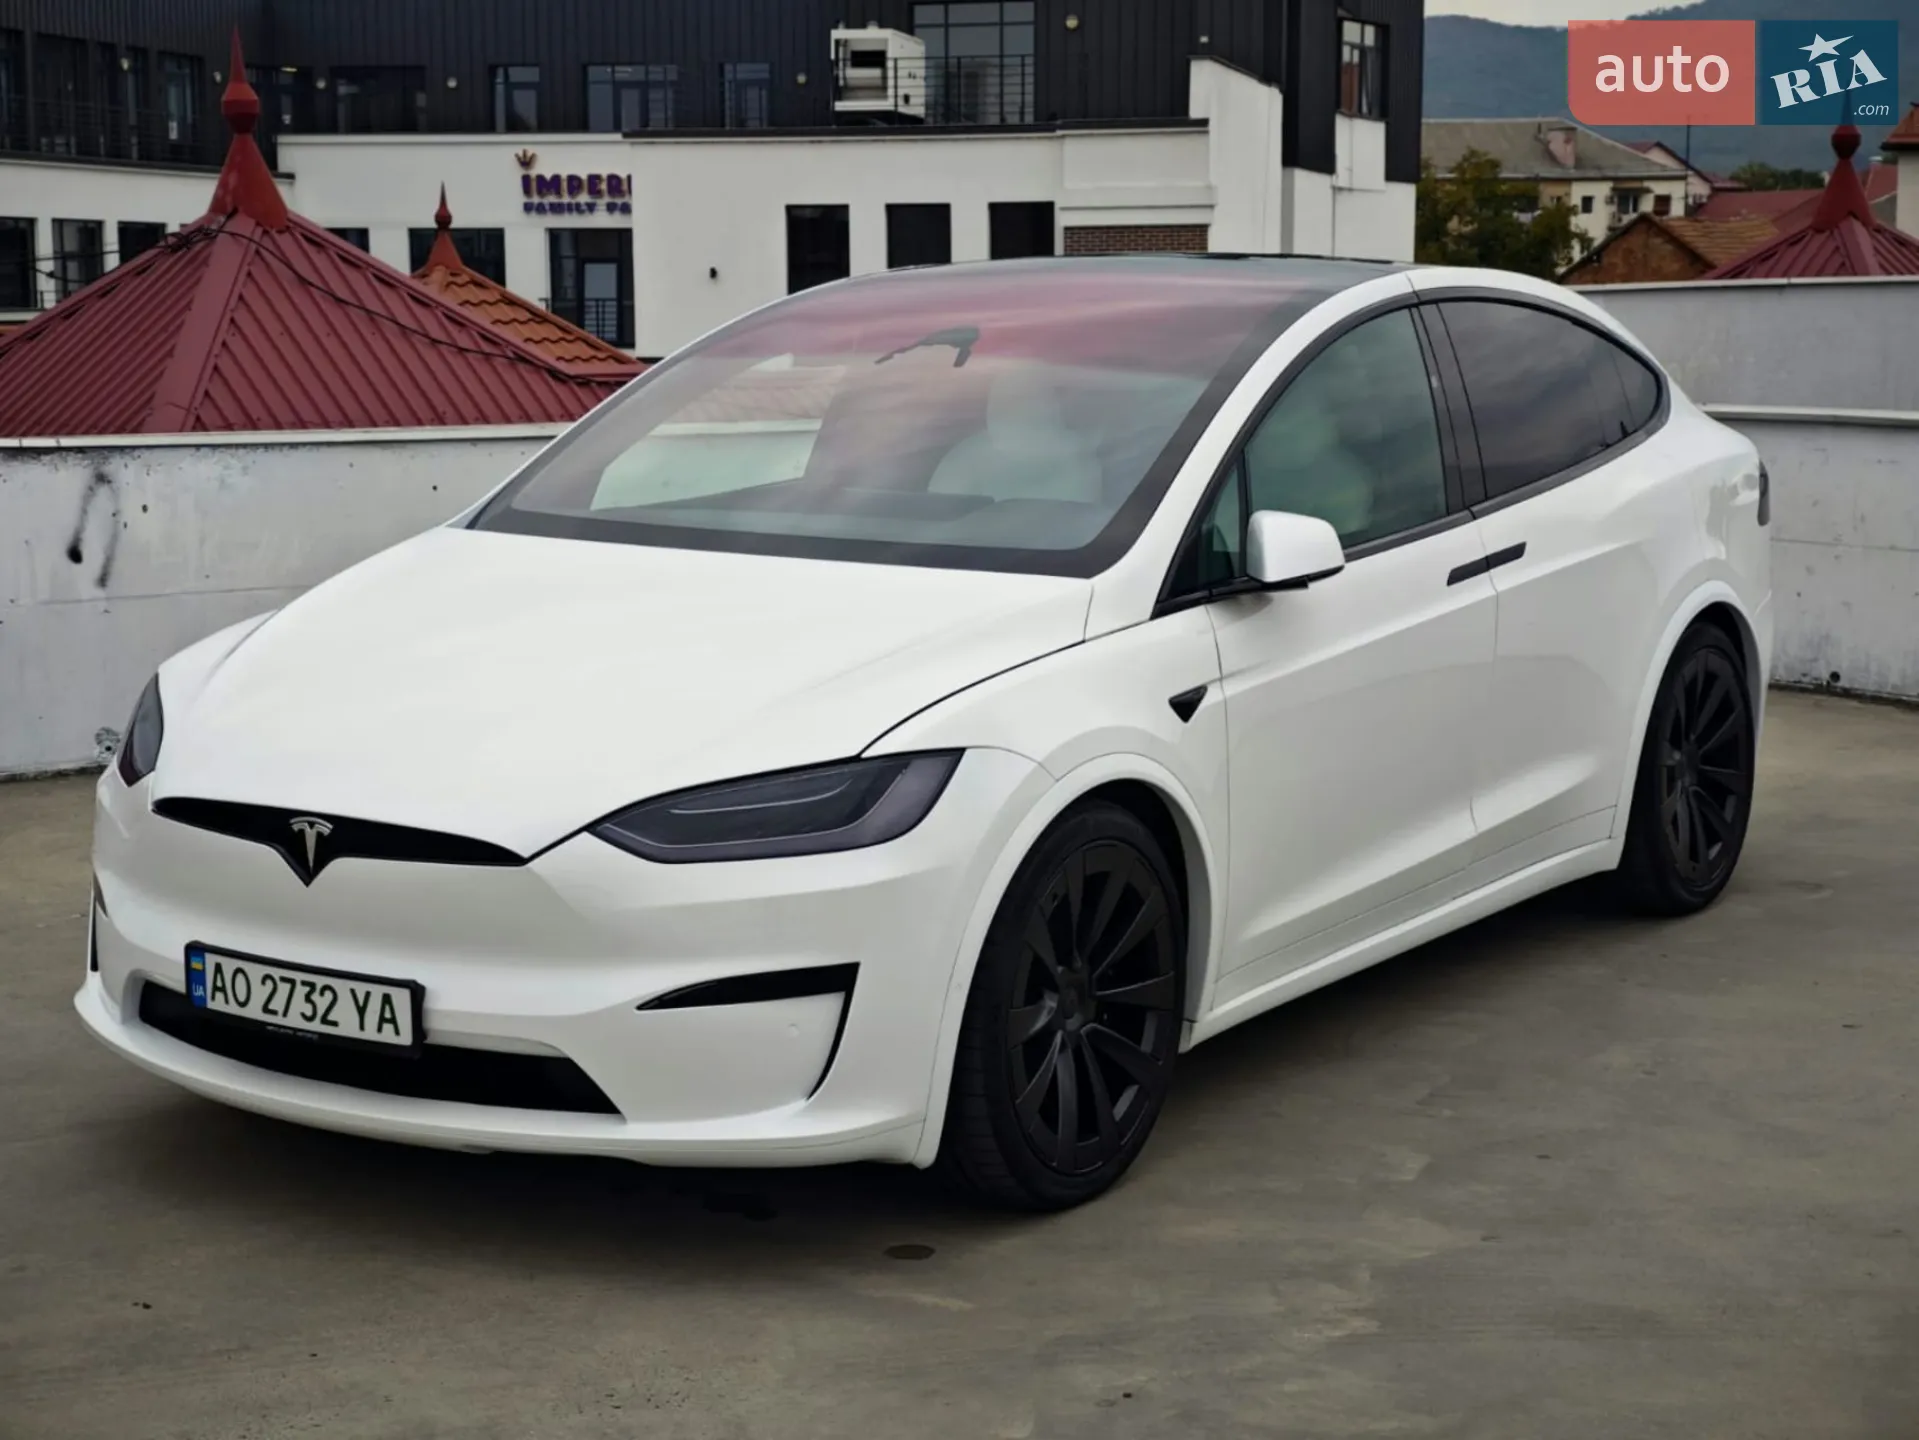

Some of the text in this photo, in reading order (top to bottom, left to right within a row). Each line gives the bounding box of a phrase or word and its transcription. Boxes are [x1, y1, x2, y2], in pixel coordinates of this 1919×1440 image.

[523, 201, 598, 215] FAMILY
[192, 984, 205, 997] UA
[210, 962, 401, 1037] AO 2732 YA
